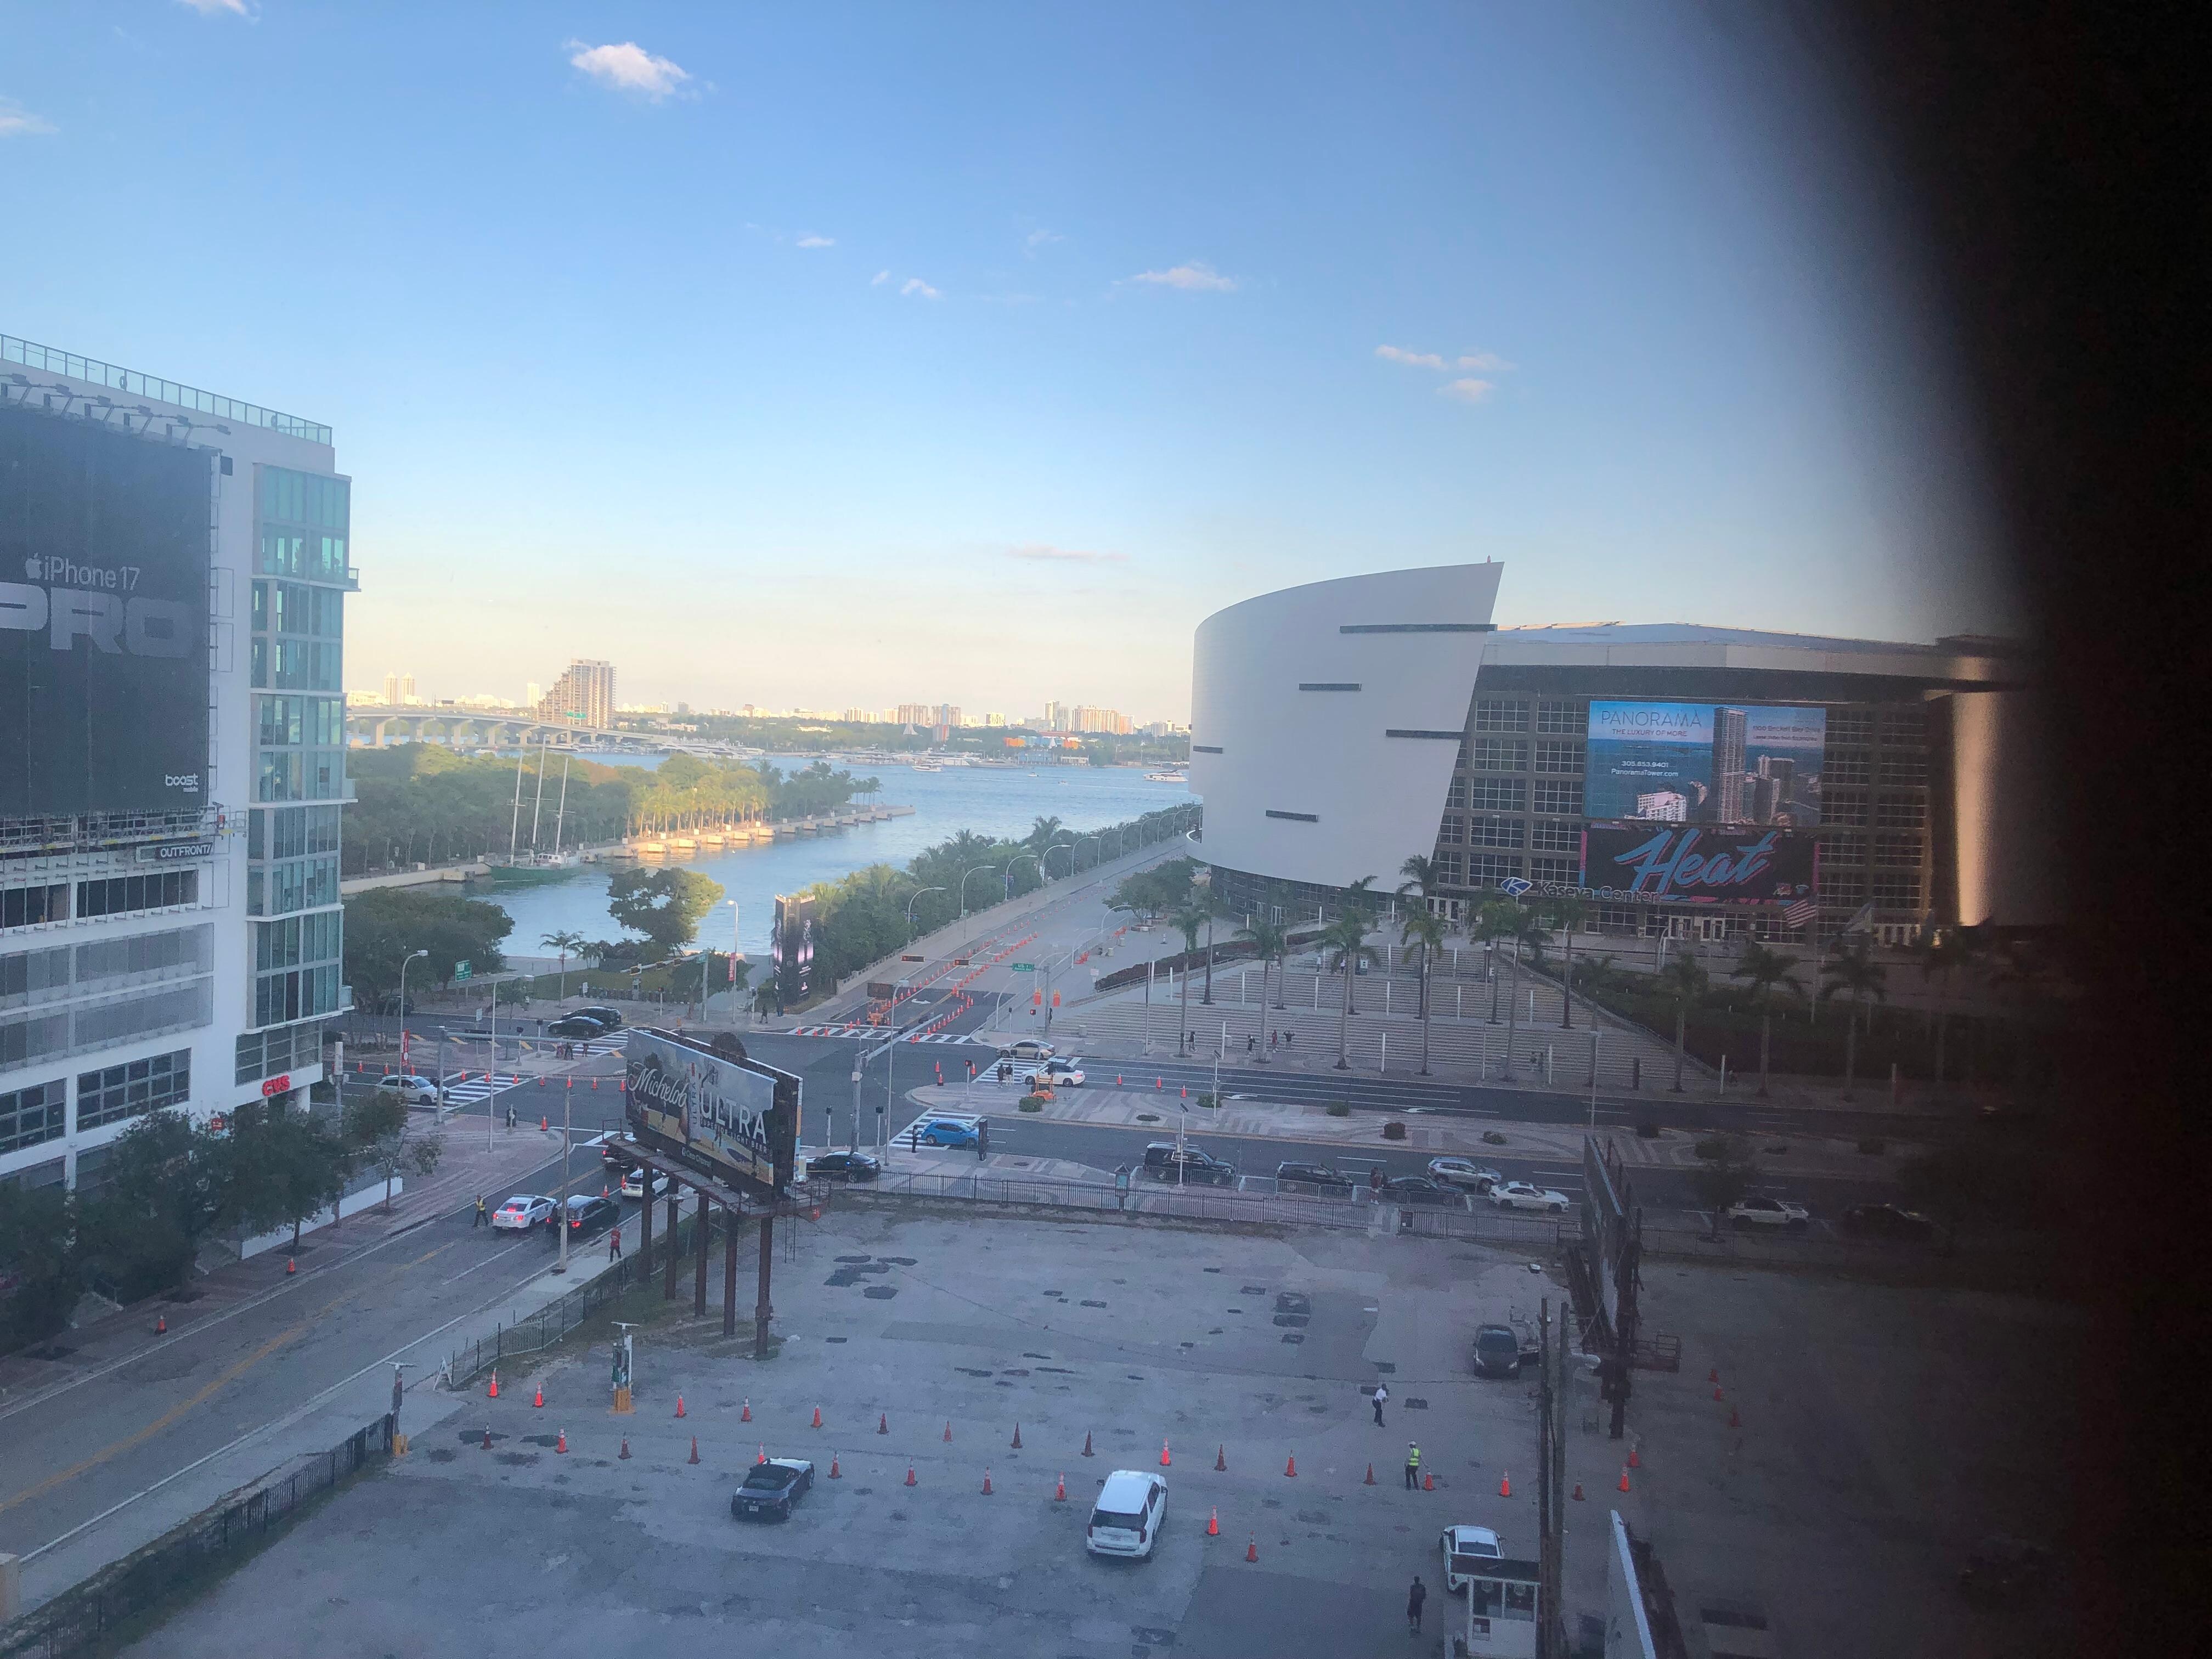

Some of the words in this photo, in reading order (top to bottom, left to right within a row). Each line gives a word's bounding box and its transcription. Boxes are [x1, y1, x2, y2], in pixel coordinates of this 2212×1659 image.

[44, 555, 117, 589] iPhone
[120, 566, 140, 591] 17
[0, 581, 193, 658] PRO
[1601, 709, 1702, 728] PANORAMA
[1611, 768, 1679, 777] PanoramaTower.com
[1614, 828, 1778, 896] Heat
[1601, 885, 1659, 904] Center
[627, 1062, 689, 1108] Michelob
[701, 1087, 767, 1144] ULTRA
